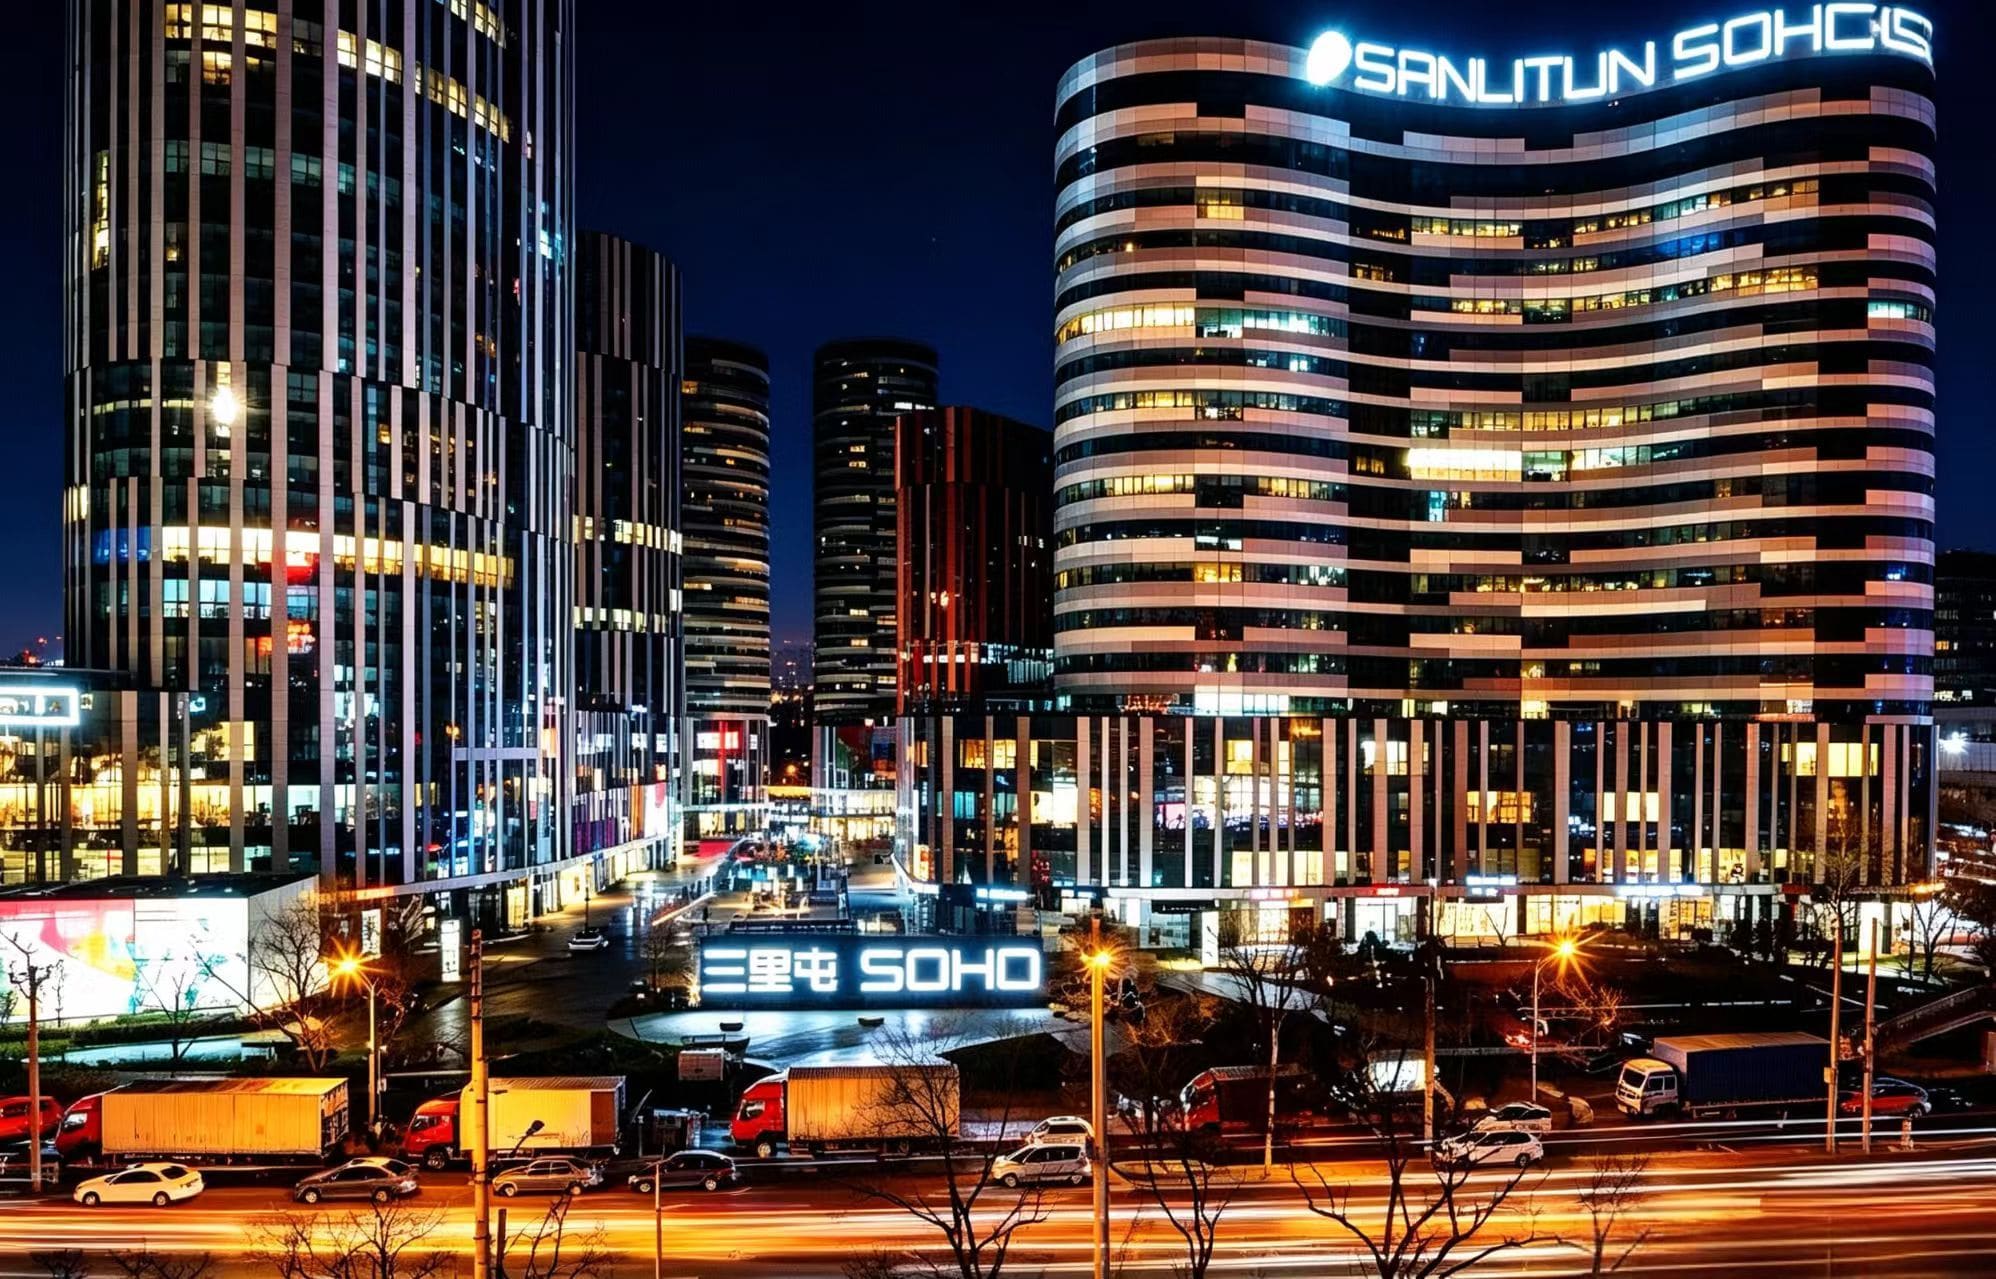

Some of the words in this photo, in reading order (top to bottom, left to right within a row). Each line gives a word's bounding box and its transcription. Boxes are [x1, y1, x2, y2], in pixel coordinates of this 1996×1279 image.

[1354, 41, 1656, 103] SANLITUN
[702, 947, 839, 992] 三里屯
[860, 948, 1042, 991] SOHO
